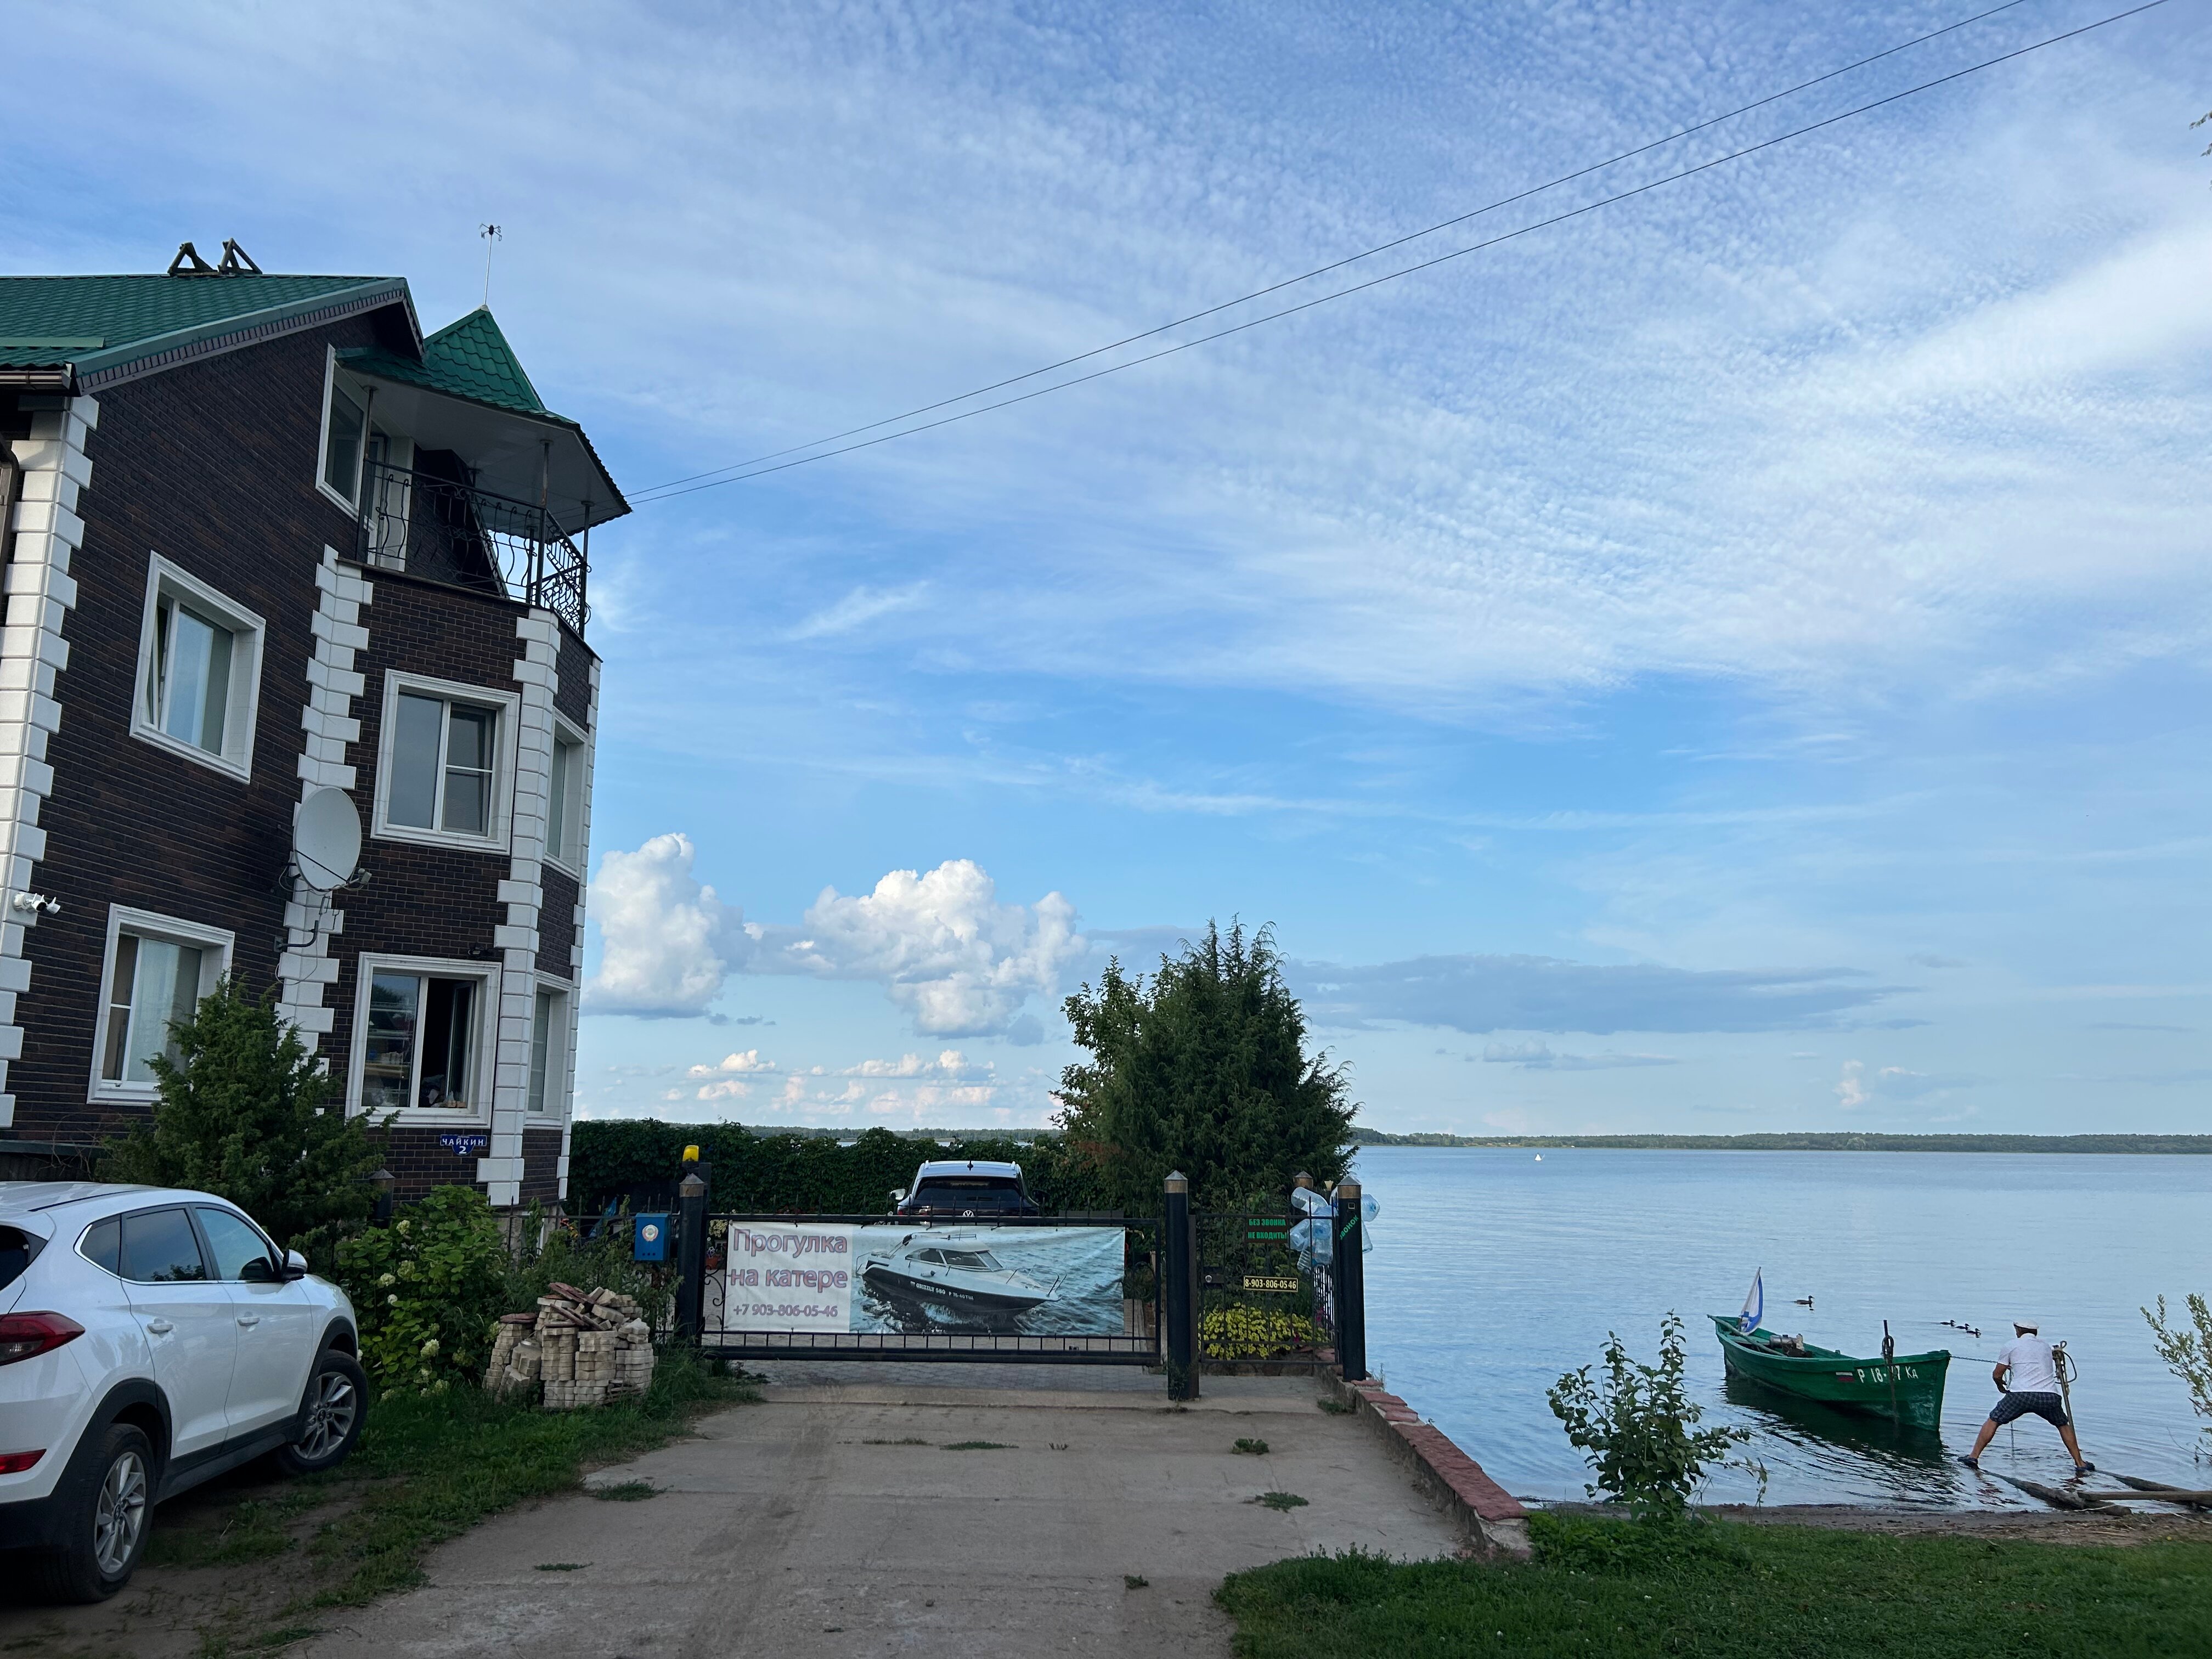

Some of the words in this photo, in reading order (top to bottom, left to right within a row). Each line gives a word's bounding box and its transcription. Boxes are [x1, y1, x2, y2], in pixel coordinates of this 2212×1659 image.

[459, 1146, 467, 1154] 2
[733, 1229, 847, 1258] Прогулка
[730, 1268, 759, 1286] на
[765, 1269, 848, 1293] катере
[916, 1283, 934, 1292] GRIZZLY
[733, 1304, 749, 1316] +7
[752, 1304, 838, 1317] 903-806-05-46
